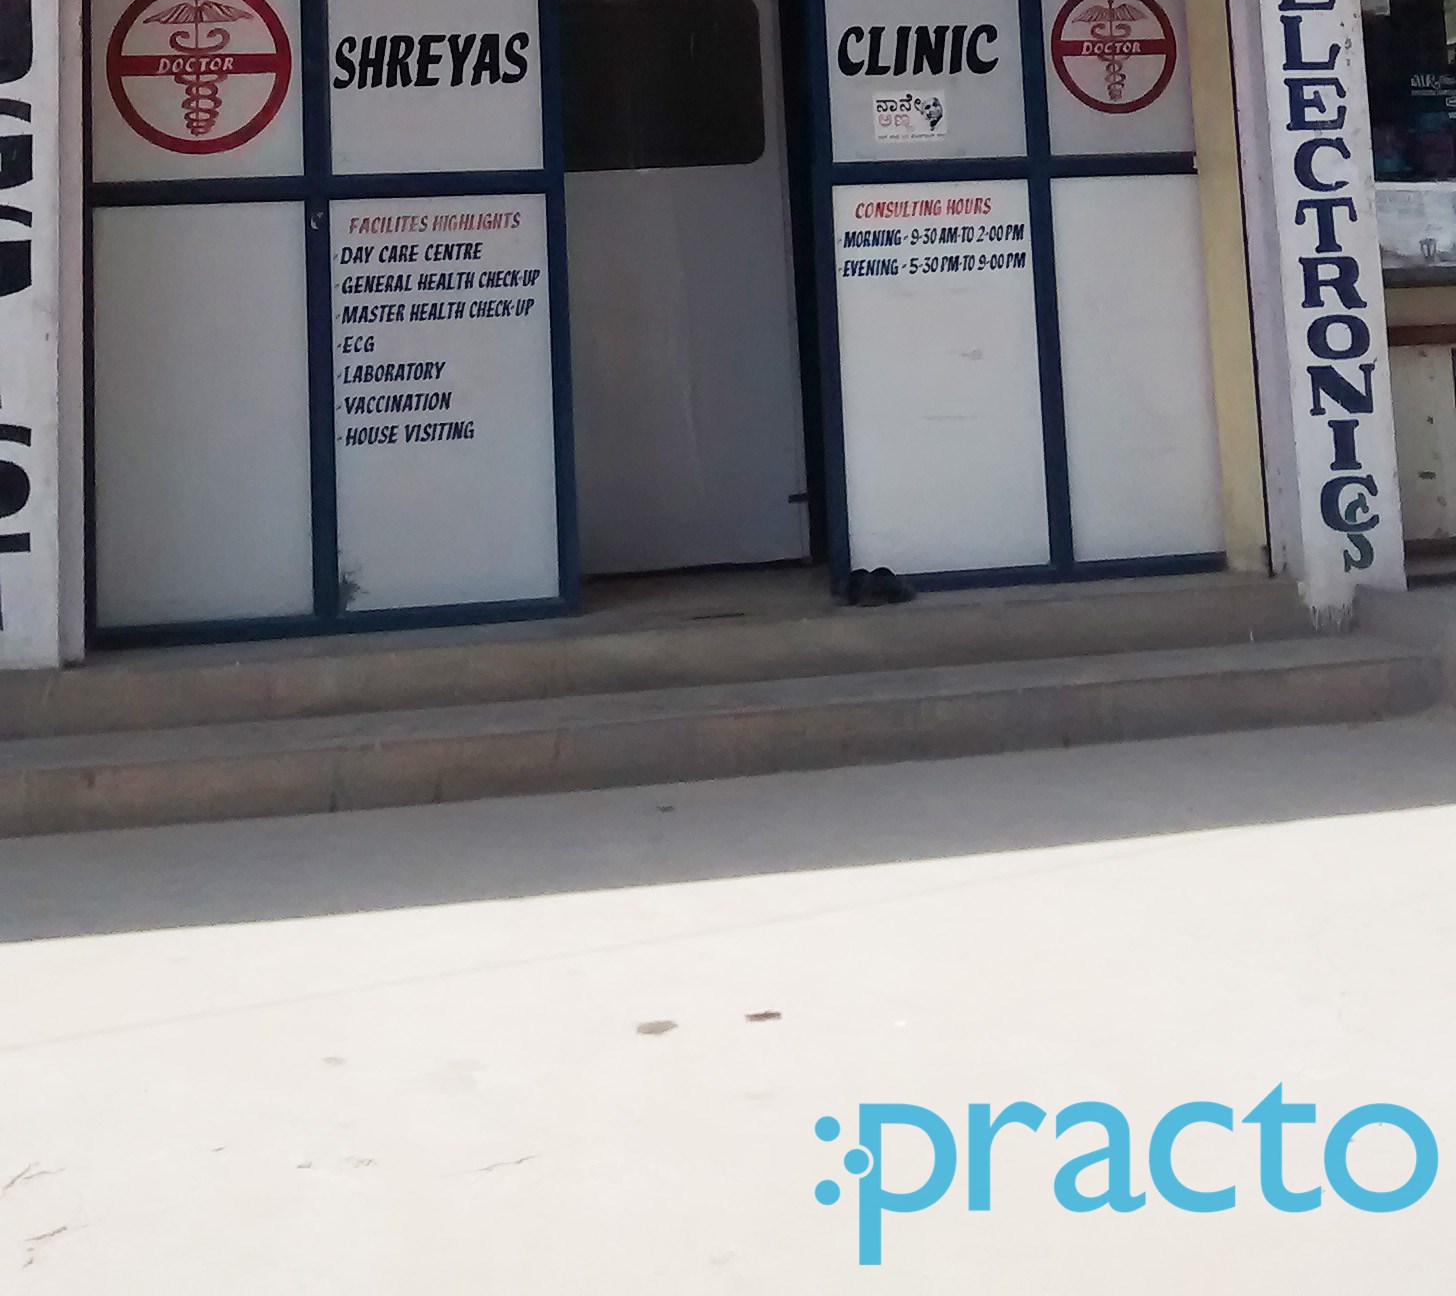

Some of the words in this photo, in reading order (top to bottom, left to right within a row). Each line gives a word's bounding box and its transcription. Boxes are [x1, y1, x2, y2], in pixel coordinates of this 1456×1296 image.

[333, 32, 530, 89] SHREYAS
[837, 24, 999, 76] CLINIC
[1081, 42, 1142, 56] DOCTOR
[157, 57, 234, 74] DOCTOR
[855, 200, 942, 220] CONSULTING
[946, 197, 992, 216] HOURS
[349, 215, 428, 234] FACILITES
[432, 211, 522, 232] HIGHLIGHTS
[340, 246, 375, 265] DAY
[378, 244, 420, 264] CARE
[424, 242, 484, 261] CENTRE
[341, 274, 414, 294] GENERAL
[417, 271, 475, 291] HEALTH
[341, 303, 405, 324] MASTER
[409, 301, 467, 322] HEALTH
[342, 335, 375, 354] ECG
[343, 361, 446, 385] LABORATORY
[344, 392, 453, 415] VACCINATION
[345, 425, 399, 447] HOUSE
[404, 420, 475, 443] VISITING
